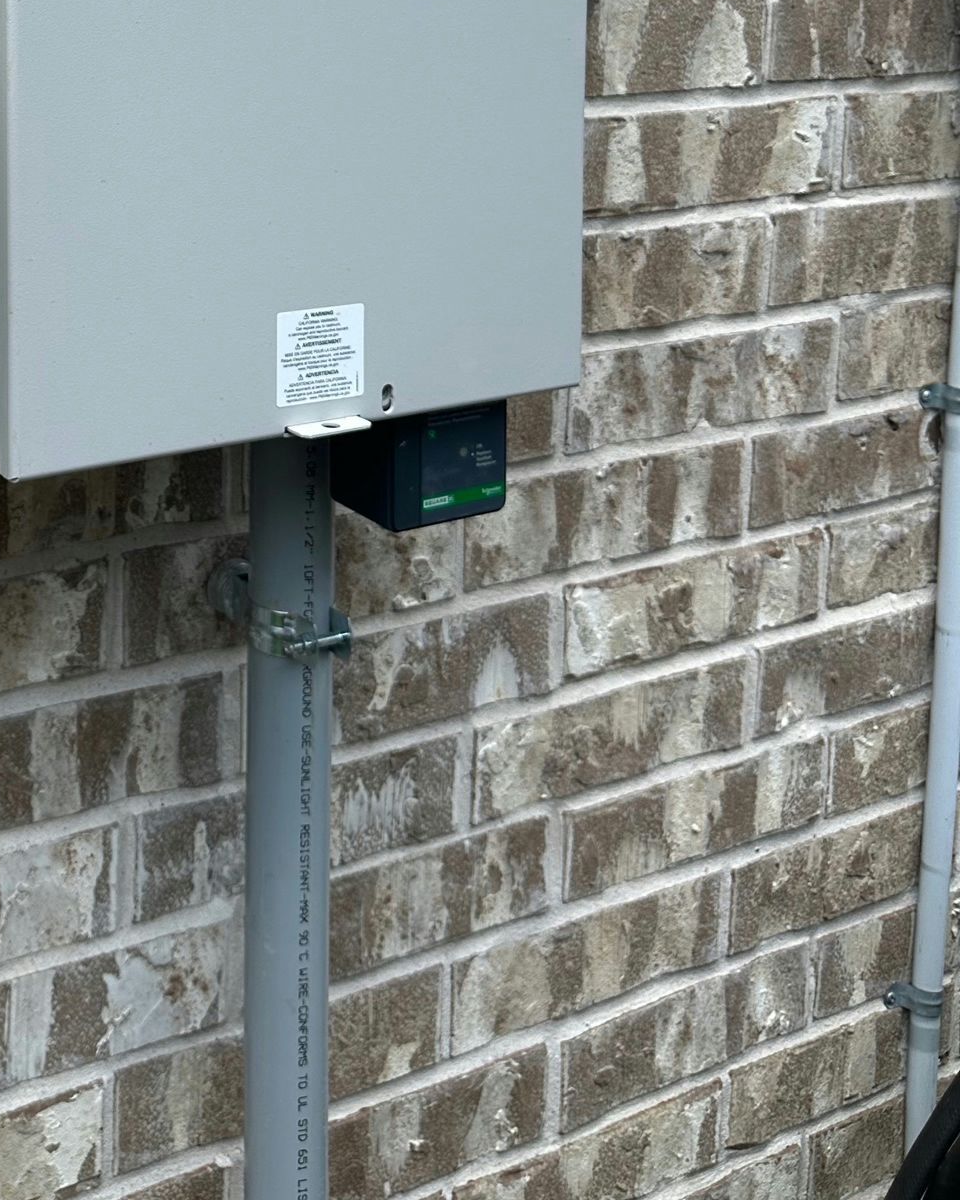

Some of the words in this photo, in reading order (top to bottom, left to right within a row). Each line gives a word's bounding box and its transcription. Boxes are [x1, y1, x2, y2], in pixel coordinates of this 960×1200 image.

[300, 724, 312, 816] USE-SUNLIGHT
[298, 824, 311, 924] RESISTANT-MAX
[298, 967, 310, 1067] WIRE-CONFORMS
[297, 1073, 308, 1090] TO
[297, 1095, 308, 1113] UL
[297, 1118, 308, 1142] STD
[297, 1148, 308, 1170] 651
